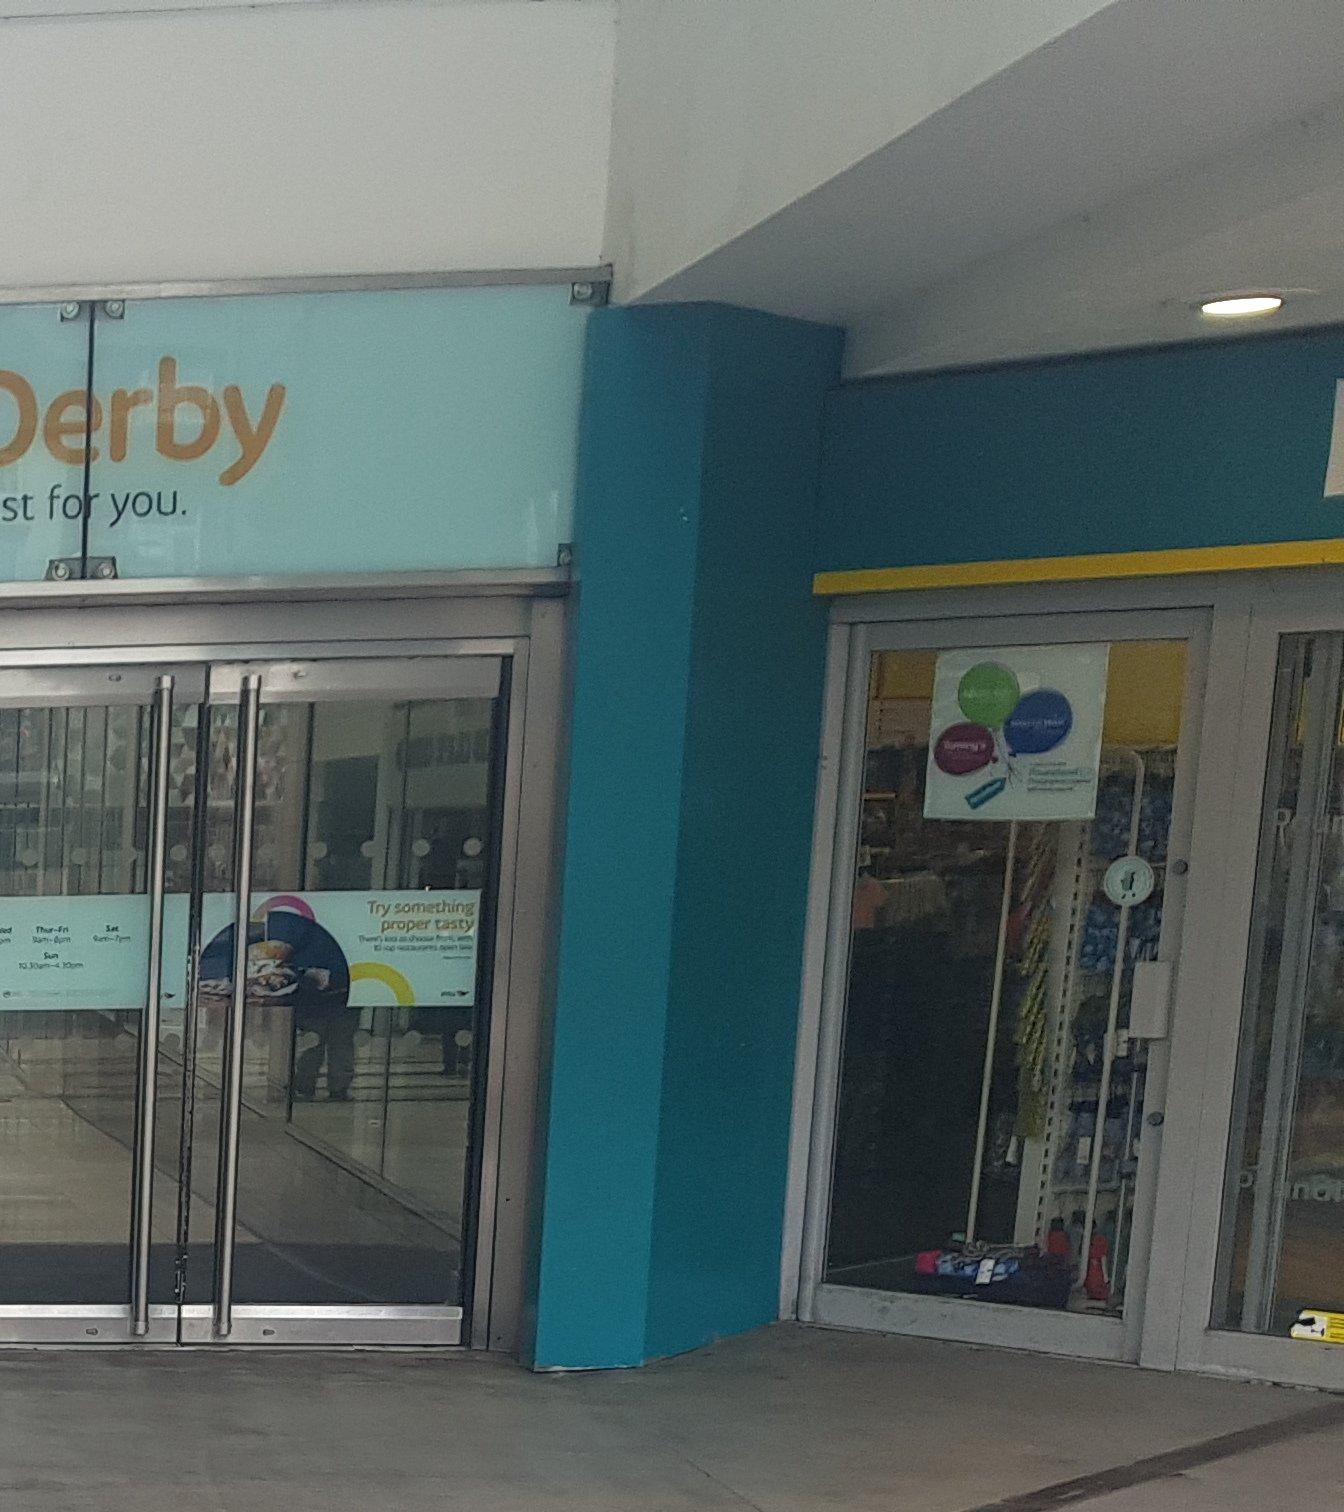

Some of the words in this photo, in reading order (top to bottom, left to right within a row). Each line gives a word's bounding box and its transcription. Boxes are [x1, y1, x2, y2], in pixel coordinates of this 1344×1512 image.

[47, 484, 102, 520] for
[108, 489, 189, 527] you.
[367, 900, 391, 917] Try
[394, 899, 475, 917] something
[380, 919, 431, 933] proper
[434, 918, 475, 933] tasty
[43, 951, 60, 960] Sun
